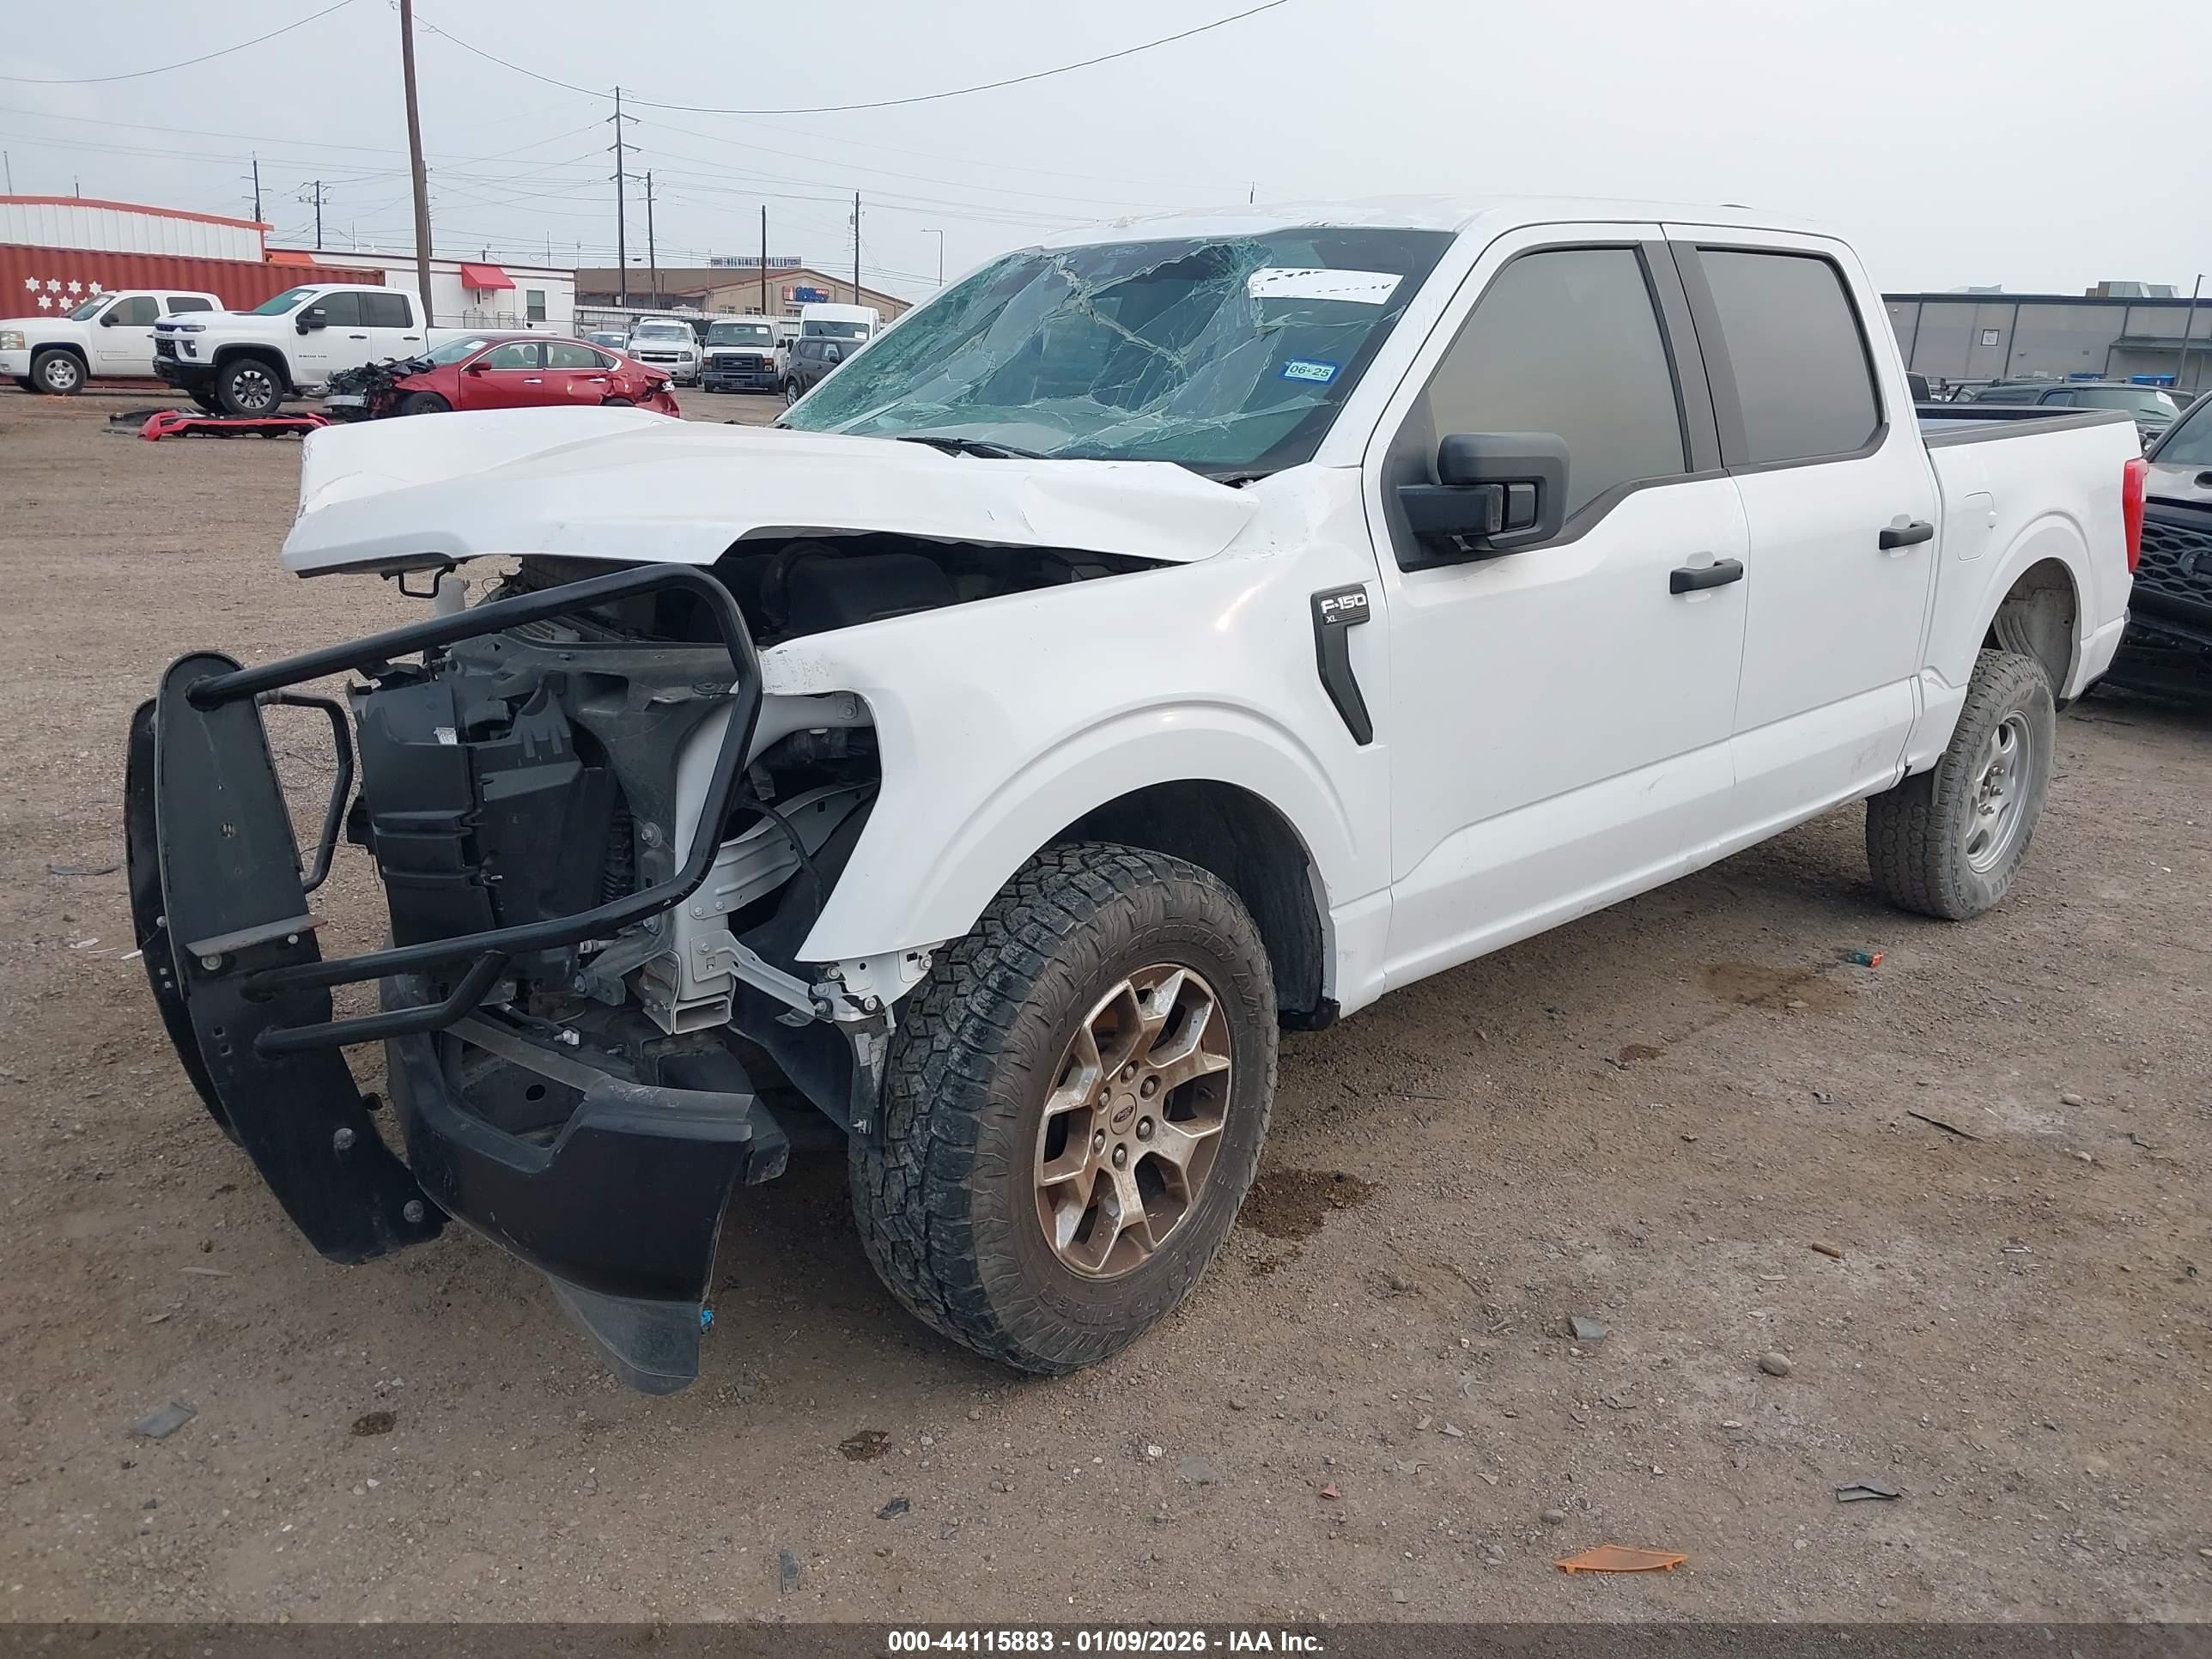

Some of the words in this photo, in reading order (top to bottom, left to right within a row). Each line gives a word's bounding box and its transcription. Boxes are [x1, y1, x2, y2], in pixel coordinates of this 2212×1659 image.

[1290, 365, 1307, 374] 06
[1311, 368, 1331, 377] 25
[1321, 592, 1367, 614] F-150
[1325, 615, 1338, 623] XL
